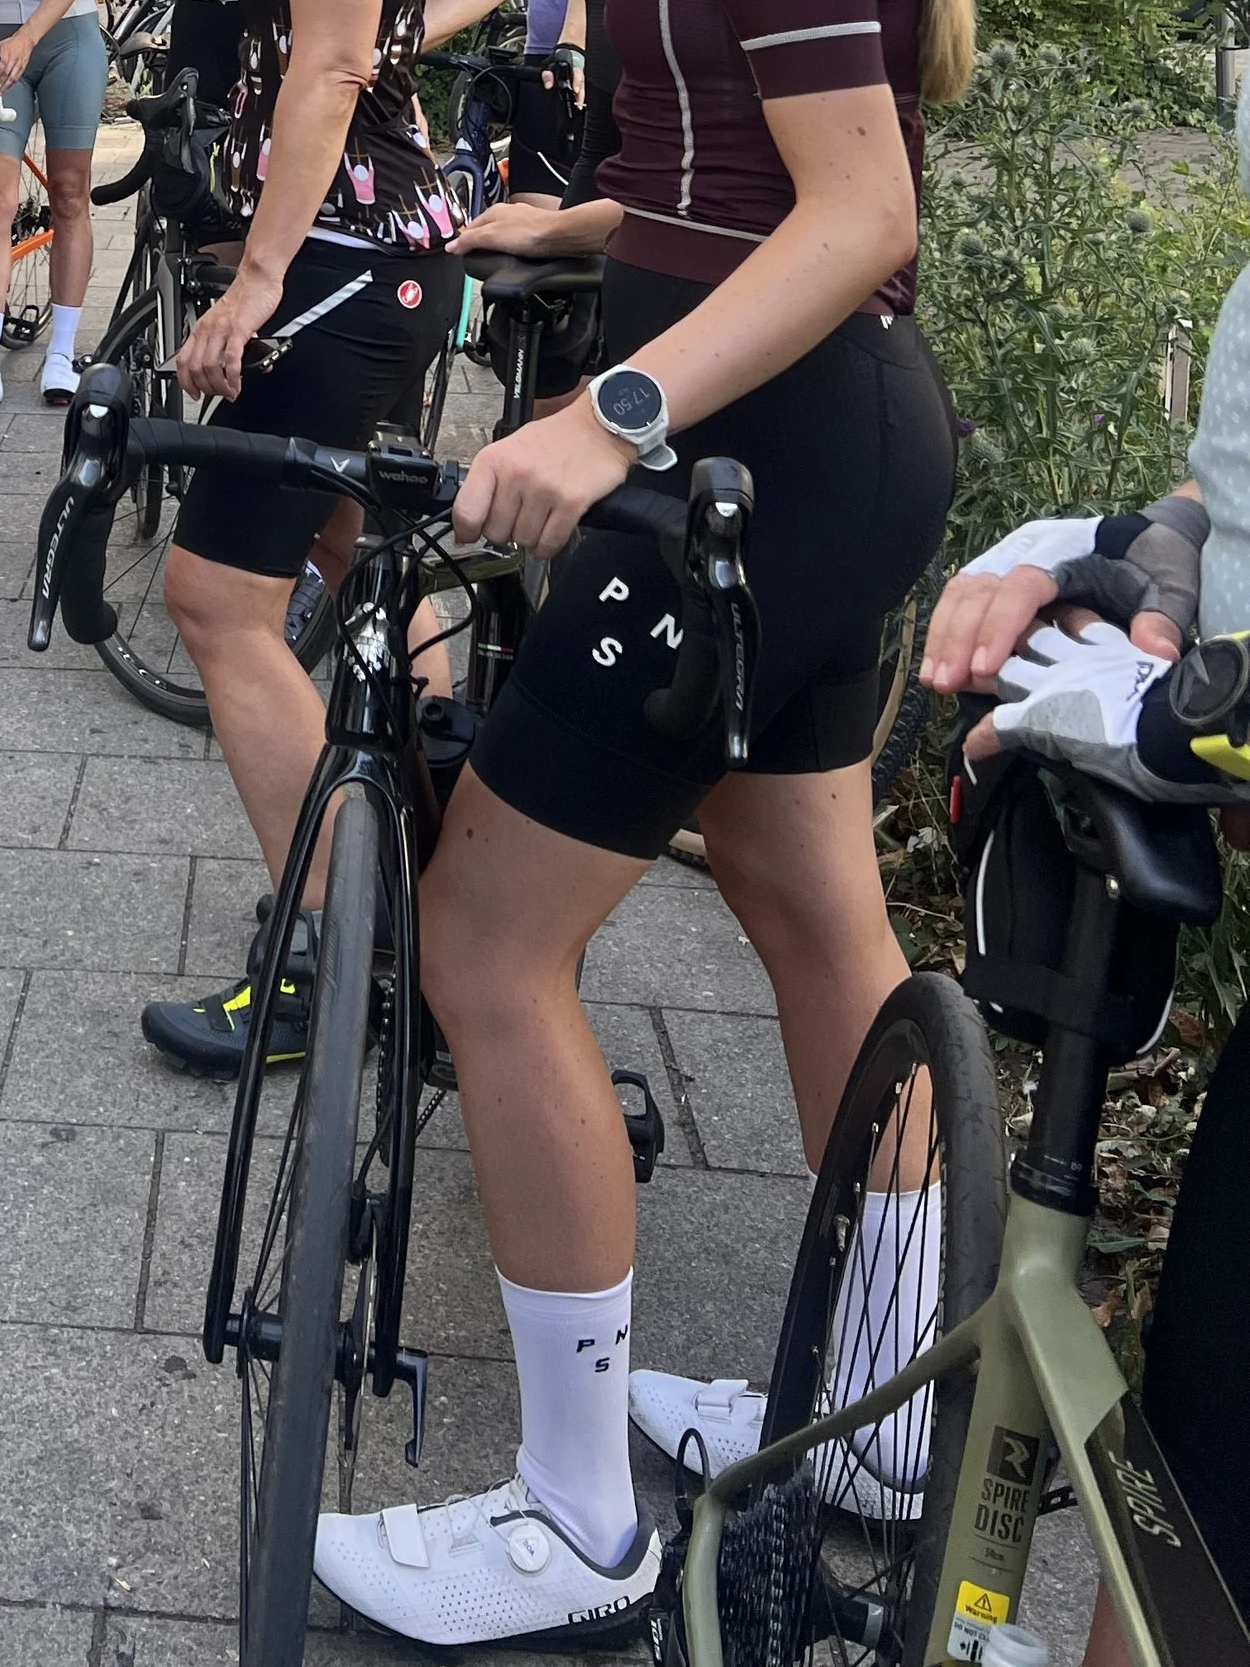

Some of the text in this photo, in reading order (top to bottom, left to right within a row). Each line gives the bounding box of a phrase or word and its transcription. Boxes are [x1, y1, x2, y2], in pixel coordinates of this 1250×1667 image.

[378, 469, 428, 485] wahoo
[42, 496, 74, 599] ULTEGRA
[731, 602, 745, 712] ULTEGRA
[981, 1478, 1030, 1513] SPIRE
[1109, 1451, 1182, 1547] SPIRE
[974, 1504, 1025, 1543] DISC
[965, 1604, 998, 1624] Warning
